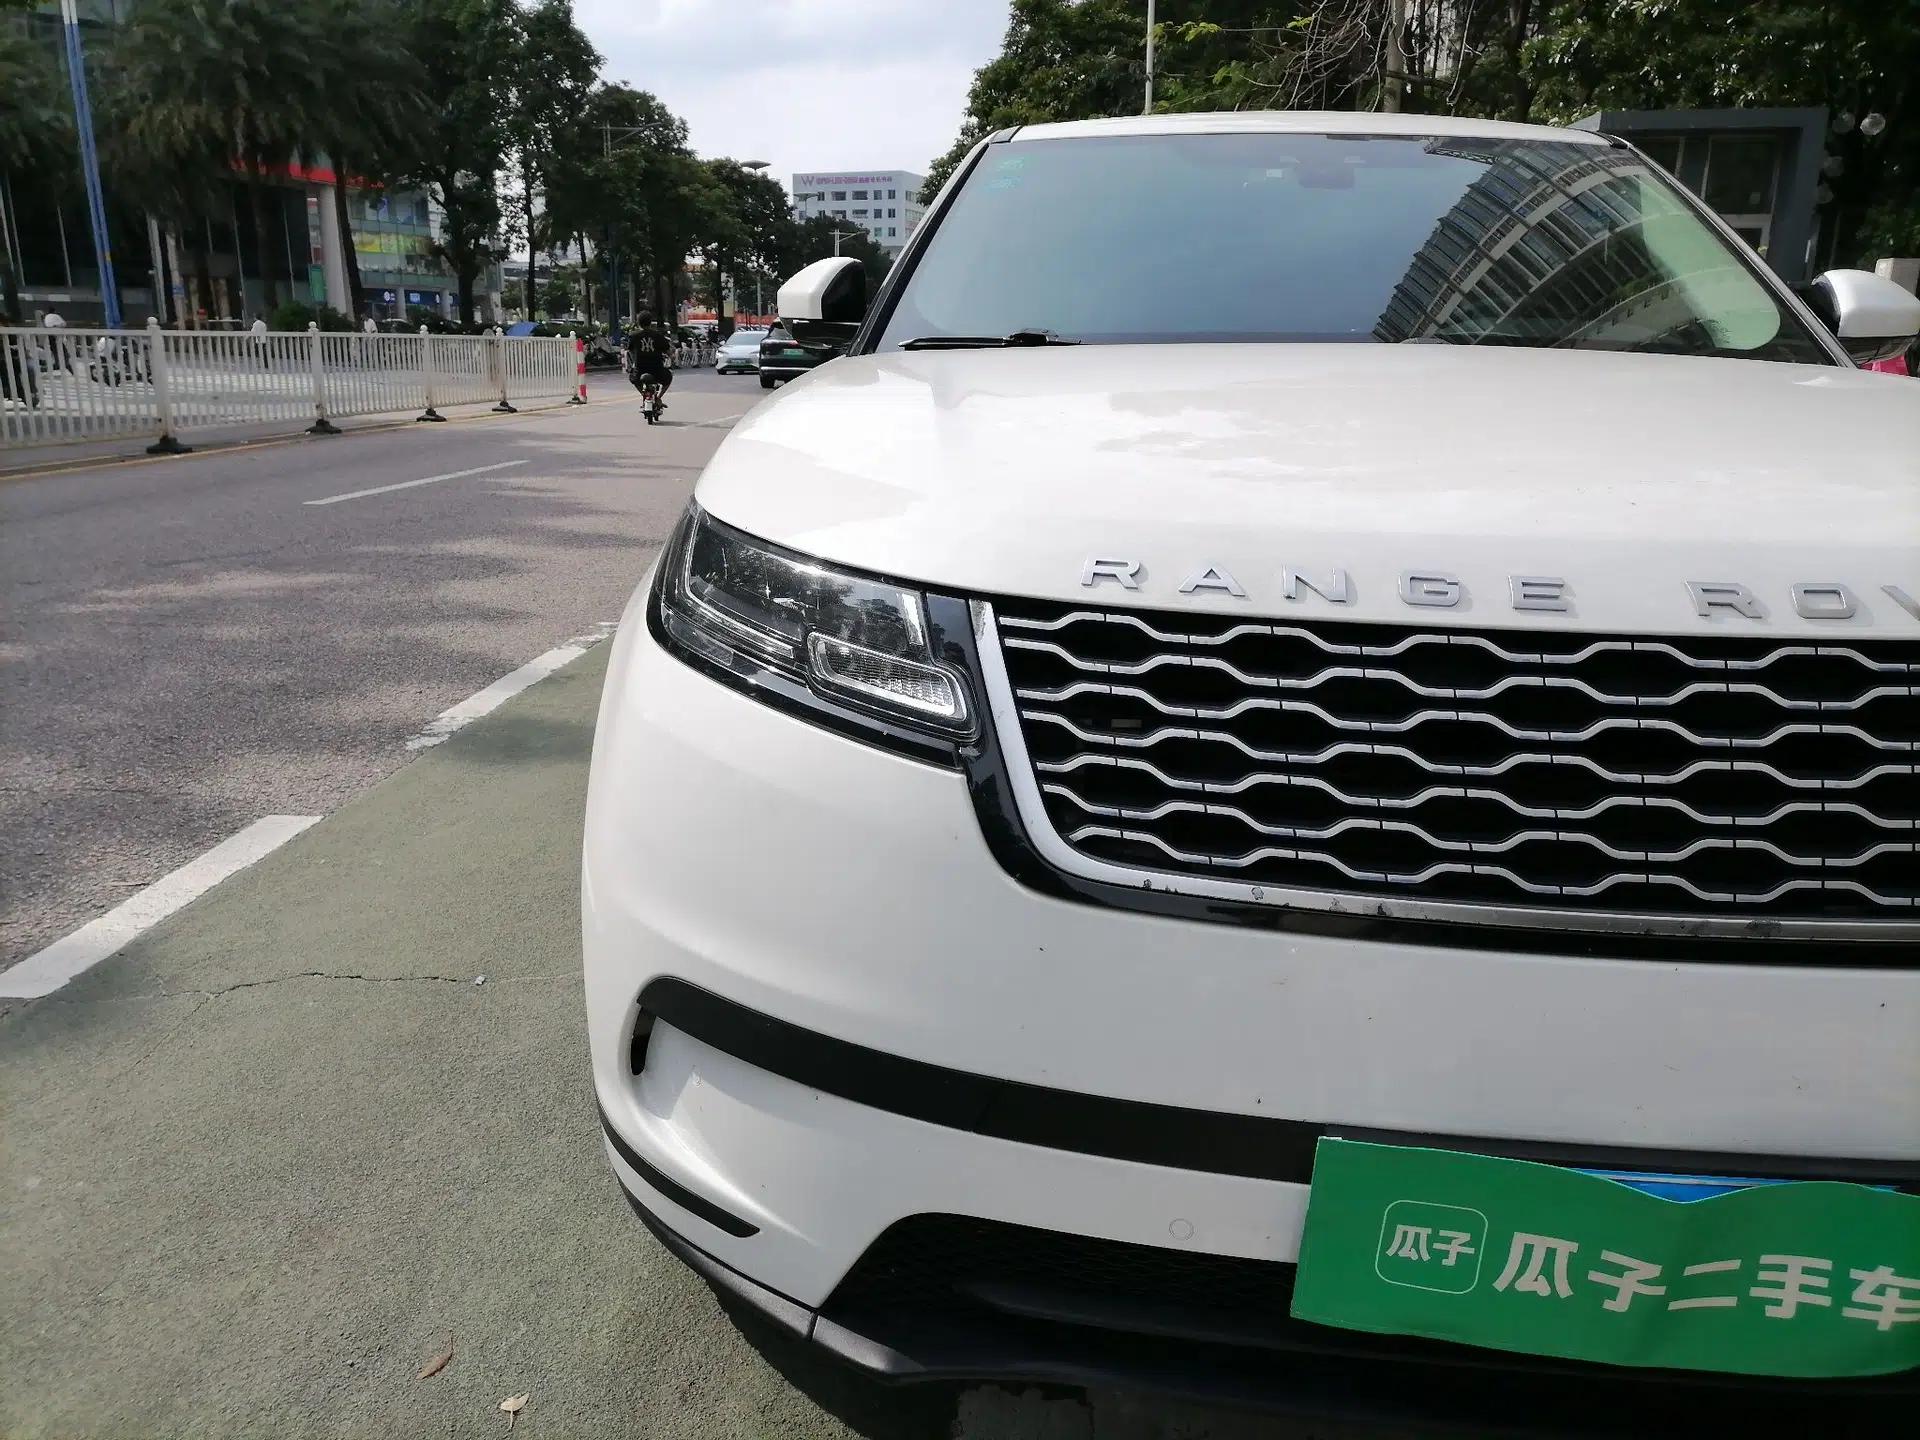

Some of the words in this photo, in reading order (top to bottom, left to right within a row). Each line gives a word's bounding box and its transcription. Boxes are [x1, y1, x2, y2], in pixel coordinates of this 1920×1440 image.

[1080, 558, 1568, 612] RANGE
[1386, 1225, 1475, 1267] 瓜子
[1493, 1231, 1920, 1332] 瓜子二手车
